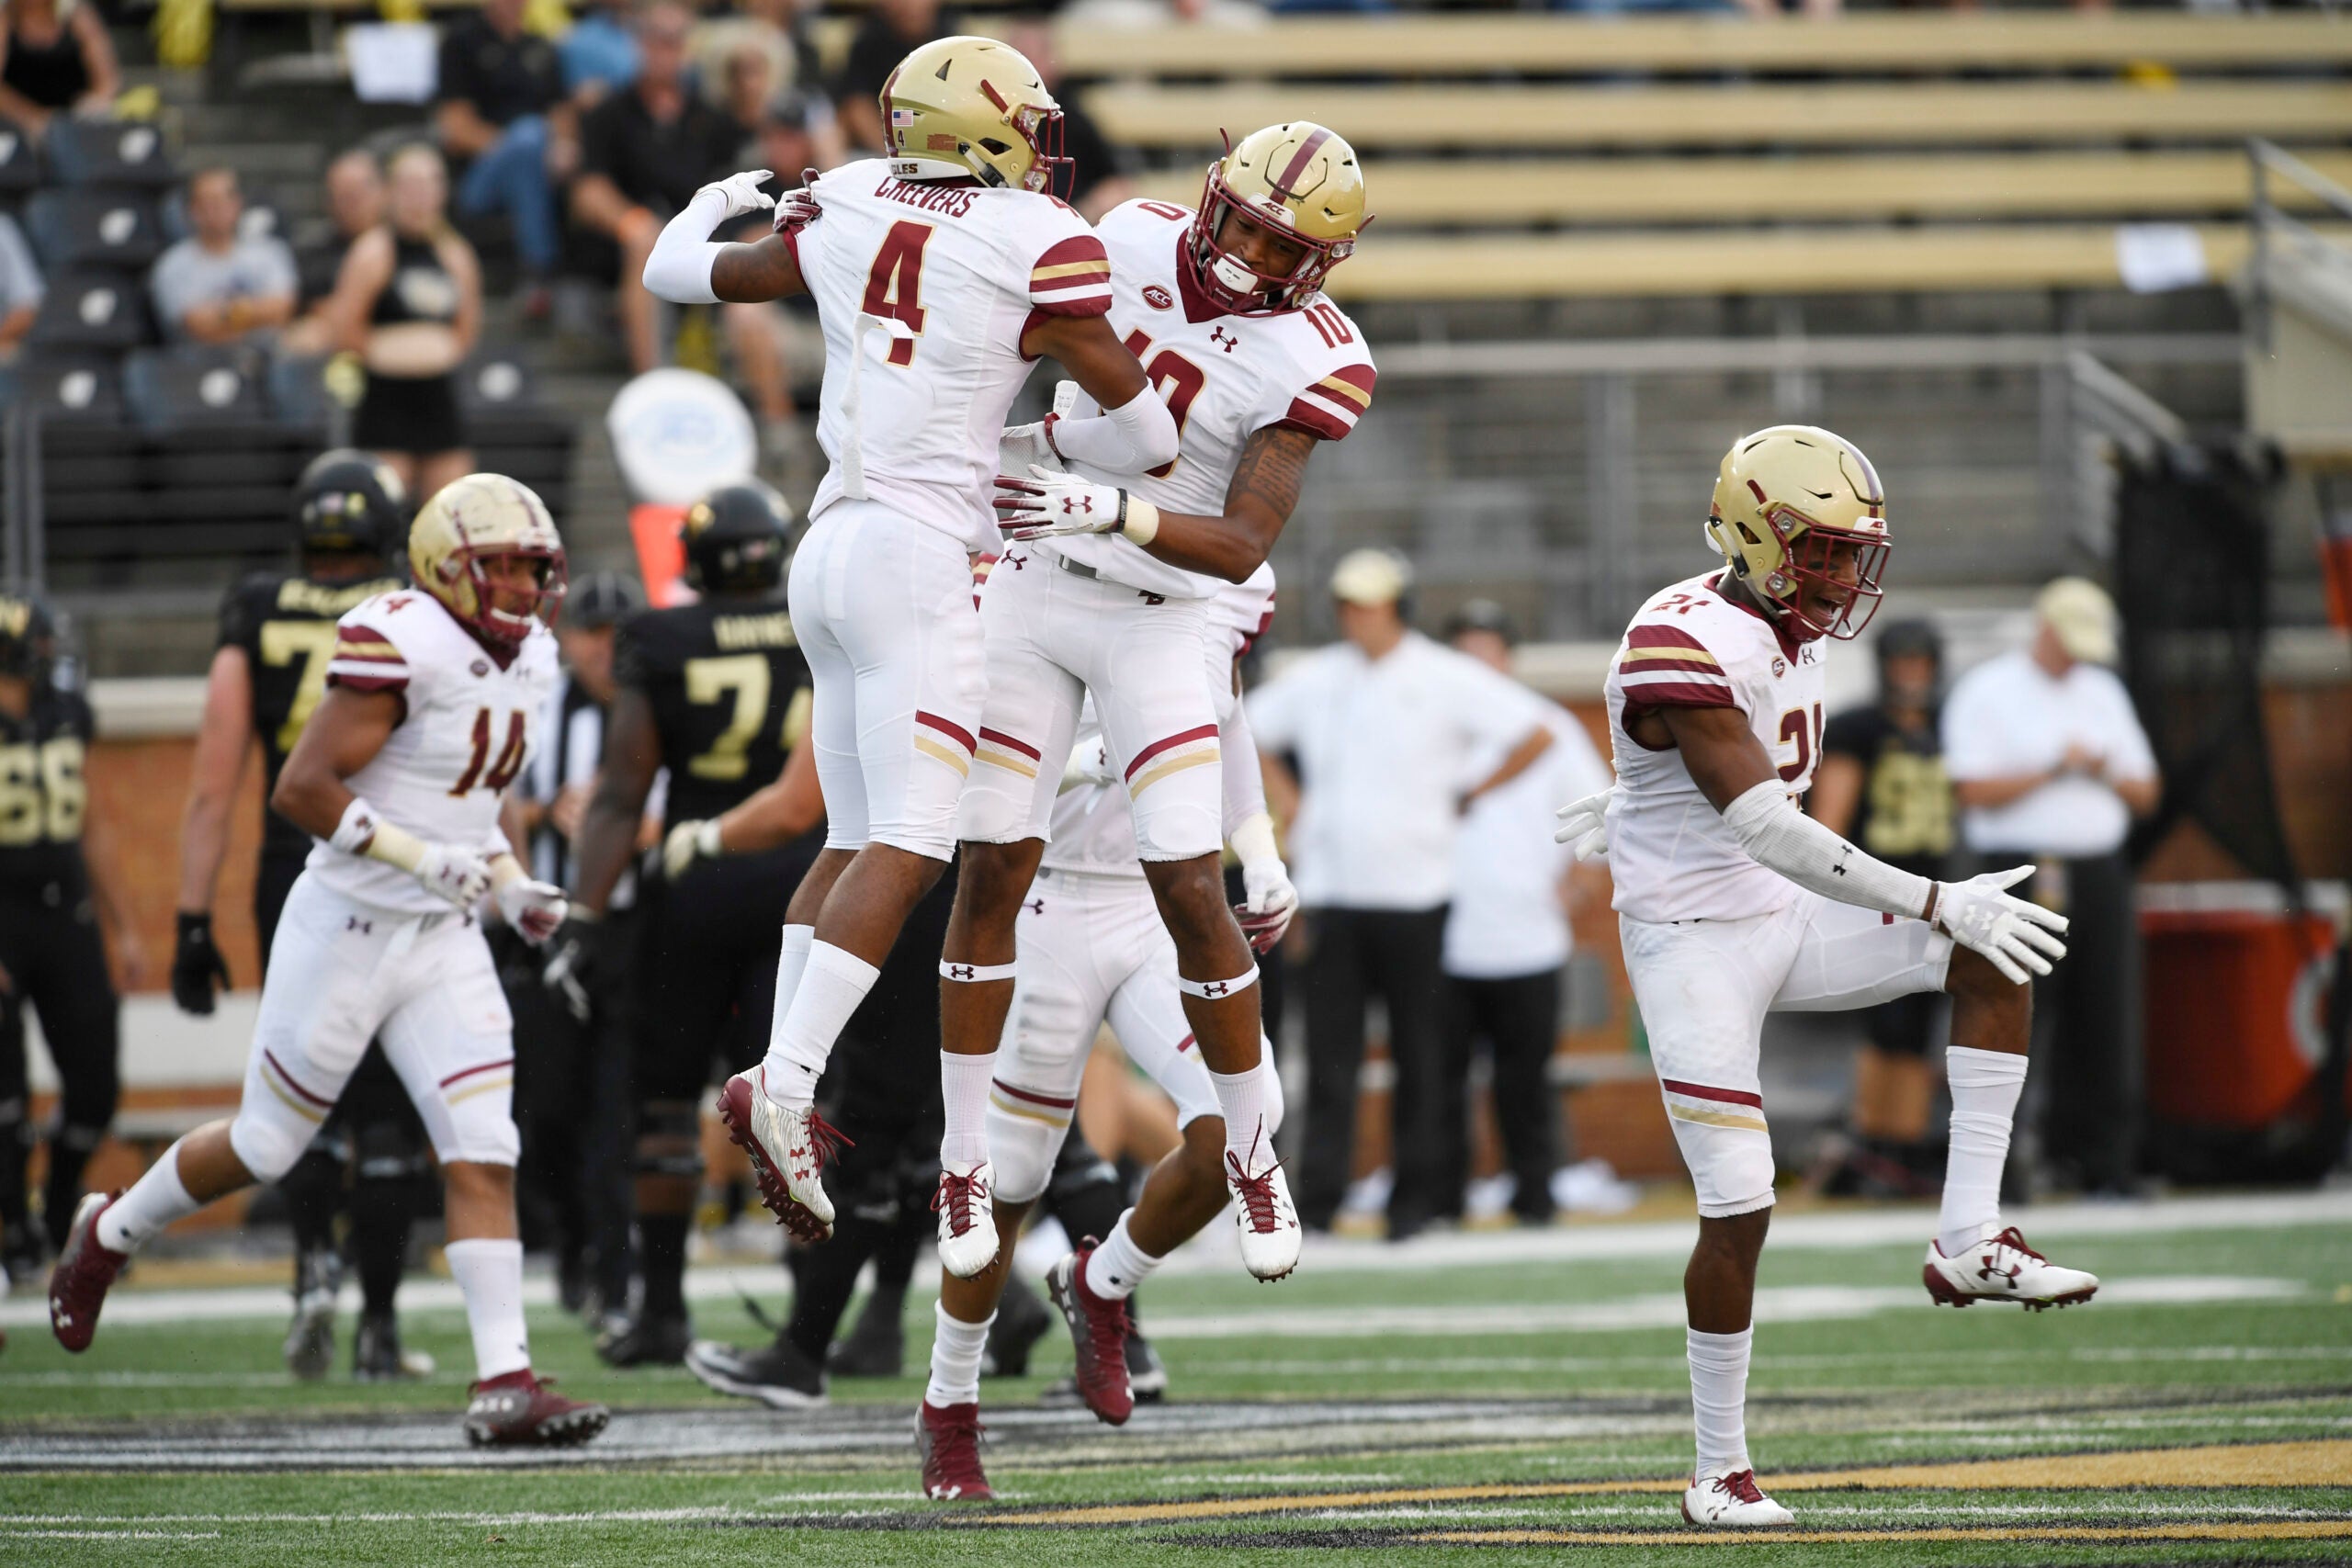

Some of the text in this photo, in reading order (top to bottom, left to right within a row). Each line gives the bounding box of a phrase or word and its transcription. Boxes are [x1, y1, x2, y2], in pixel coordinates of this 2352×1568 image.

[898, 130, 905, 147] 4
[874, 176, 980, 219] CHEEVERS
[1260, 201, 1285, 216] ACC
[861, 219, 937, 369] 4
[1145, 289, 1171, 306] ACC
[1302, 303, 1354, 350] 10
[448, 708, 526, 797] 14
[0, 738, 86, 846] 66
